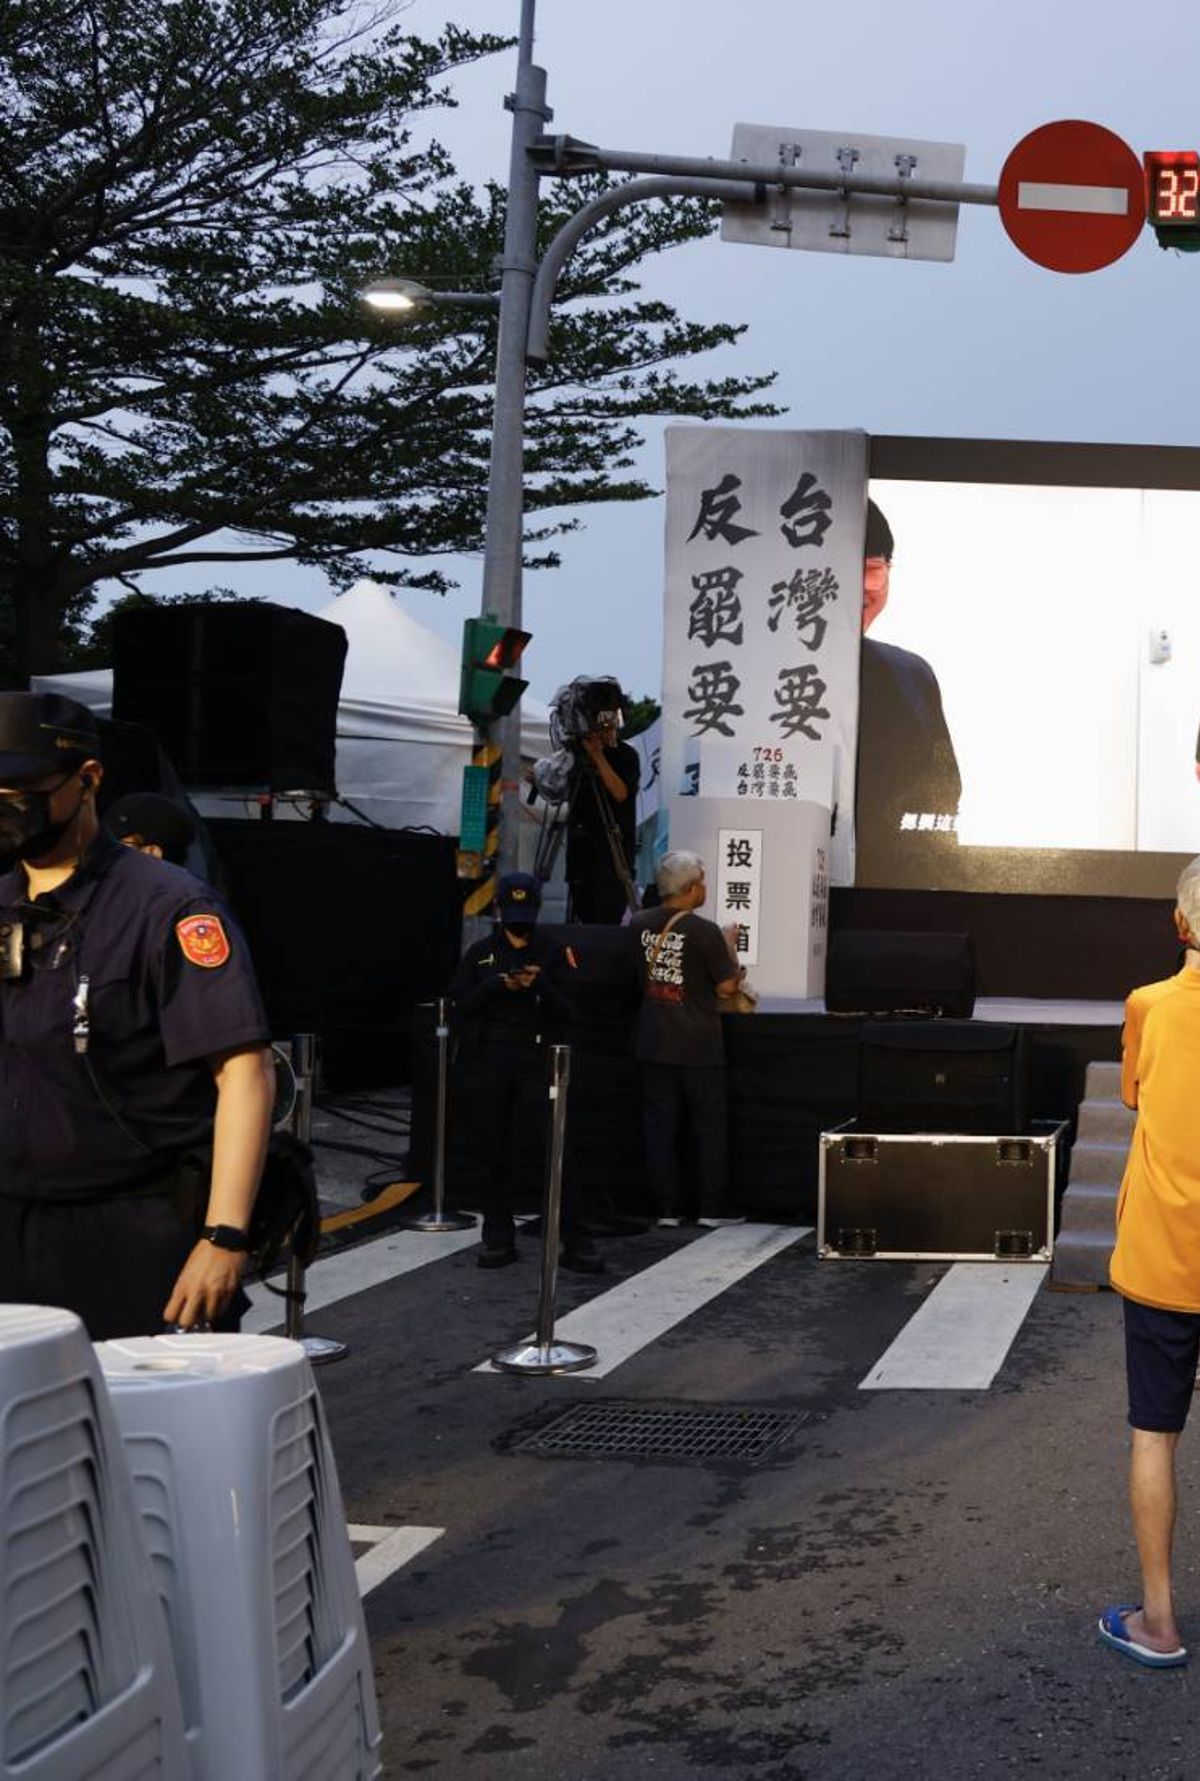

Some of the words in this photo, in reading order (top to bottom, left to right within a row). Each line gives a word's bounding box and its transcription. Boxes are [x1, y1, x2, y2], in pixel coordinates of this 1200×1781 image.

[1158, 170, 1198, 217] 32
[679, 474, 761, 796] 反罷要
[767, 472, 839, 836] 台灣要
[752, 747, 783, 762] 726
